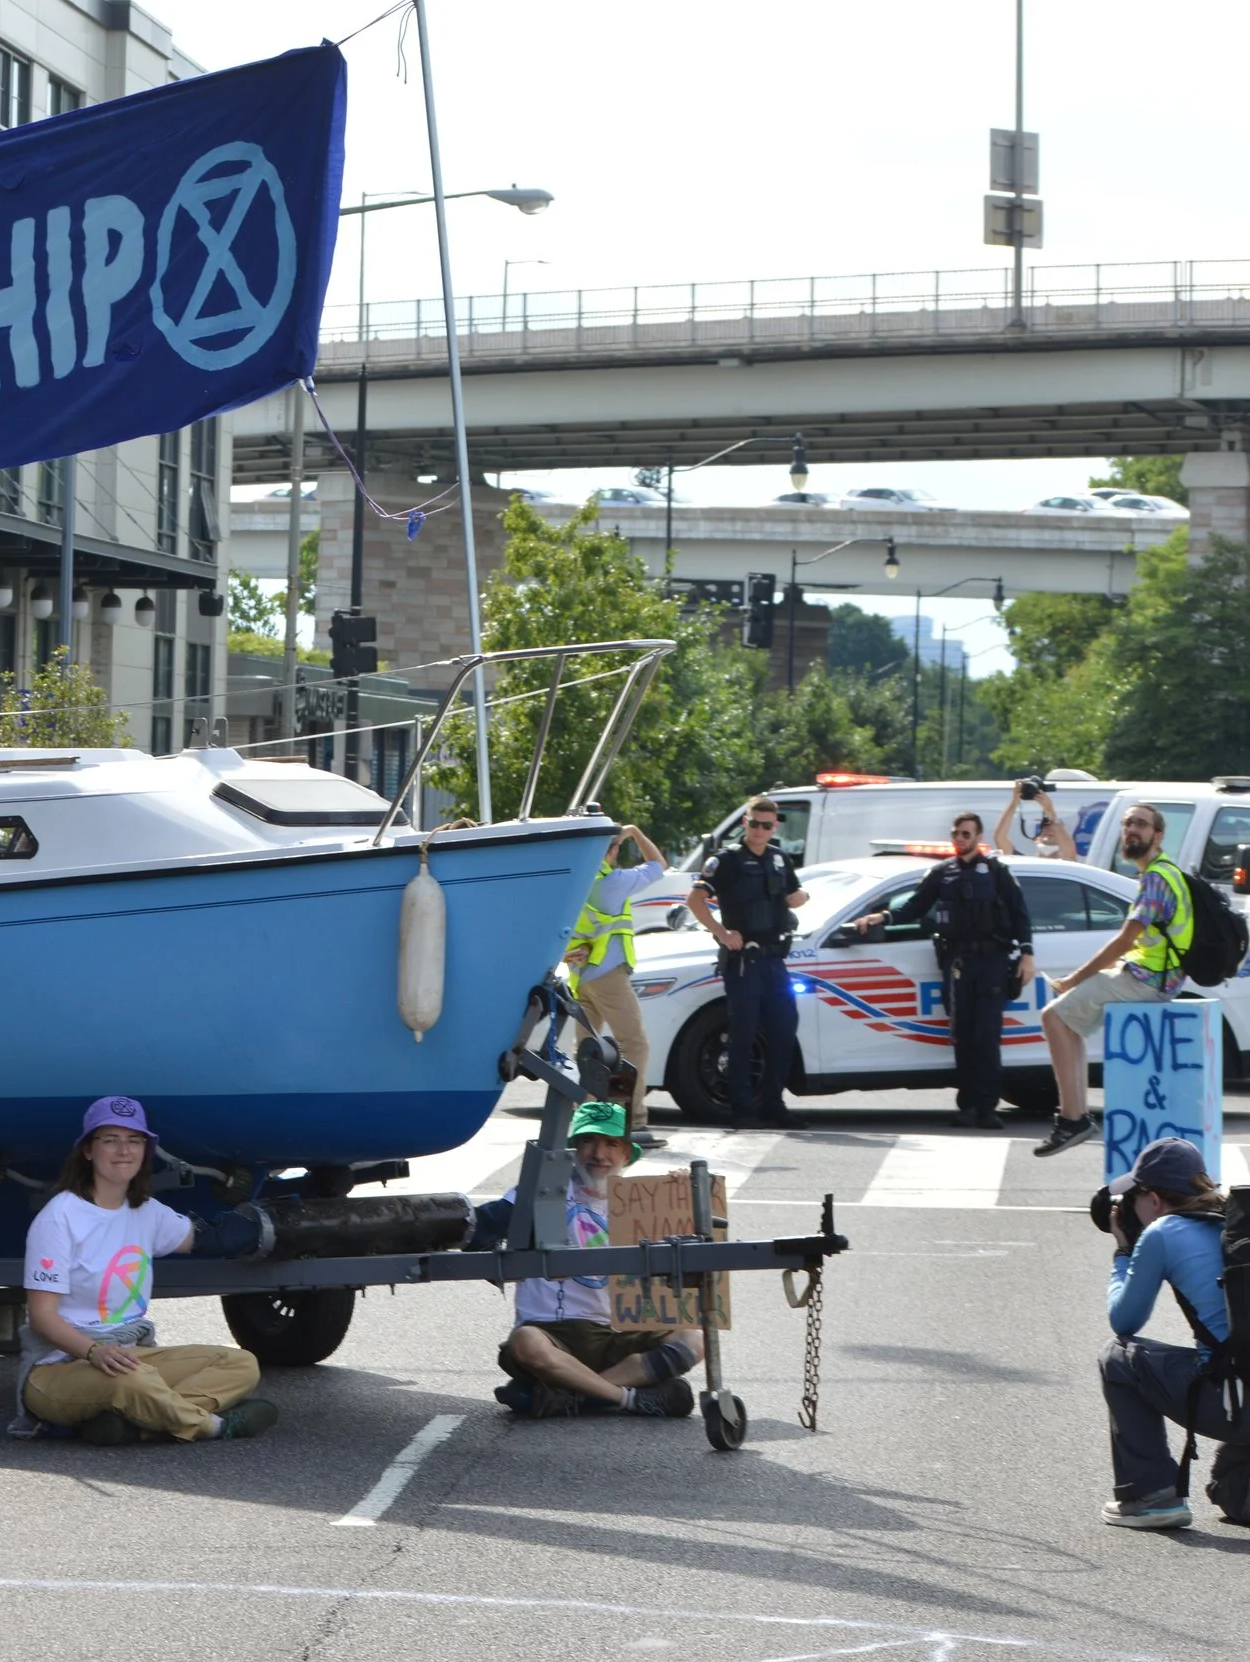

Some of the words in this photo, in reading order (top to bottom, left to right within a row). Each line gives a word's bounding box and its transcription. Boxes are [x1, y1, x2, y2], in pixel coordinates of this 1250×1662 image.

[1105, 1009, 1203, 1072] LOVE
[1144, 1075, 1166, 1110] &
[611, 1183, 660, 1217] SAY
[661, 1180, 727, 1213] THR
